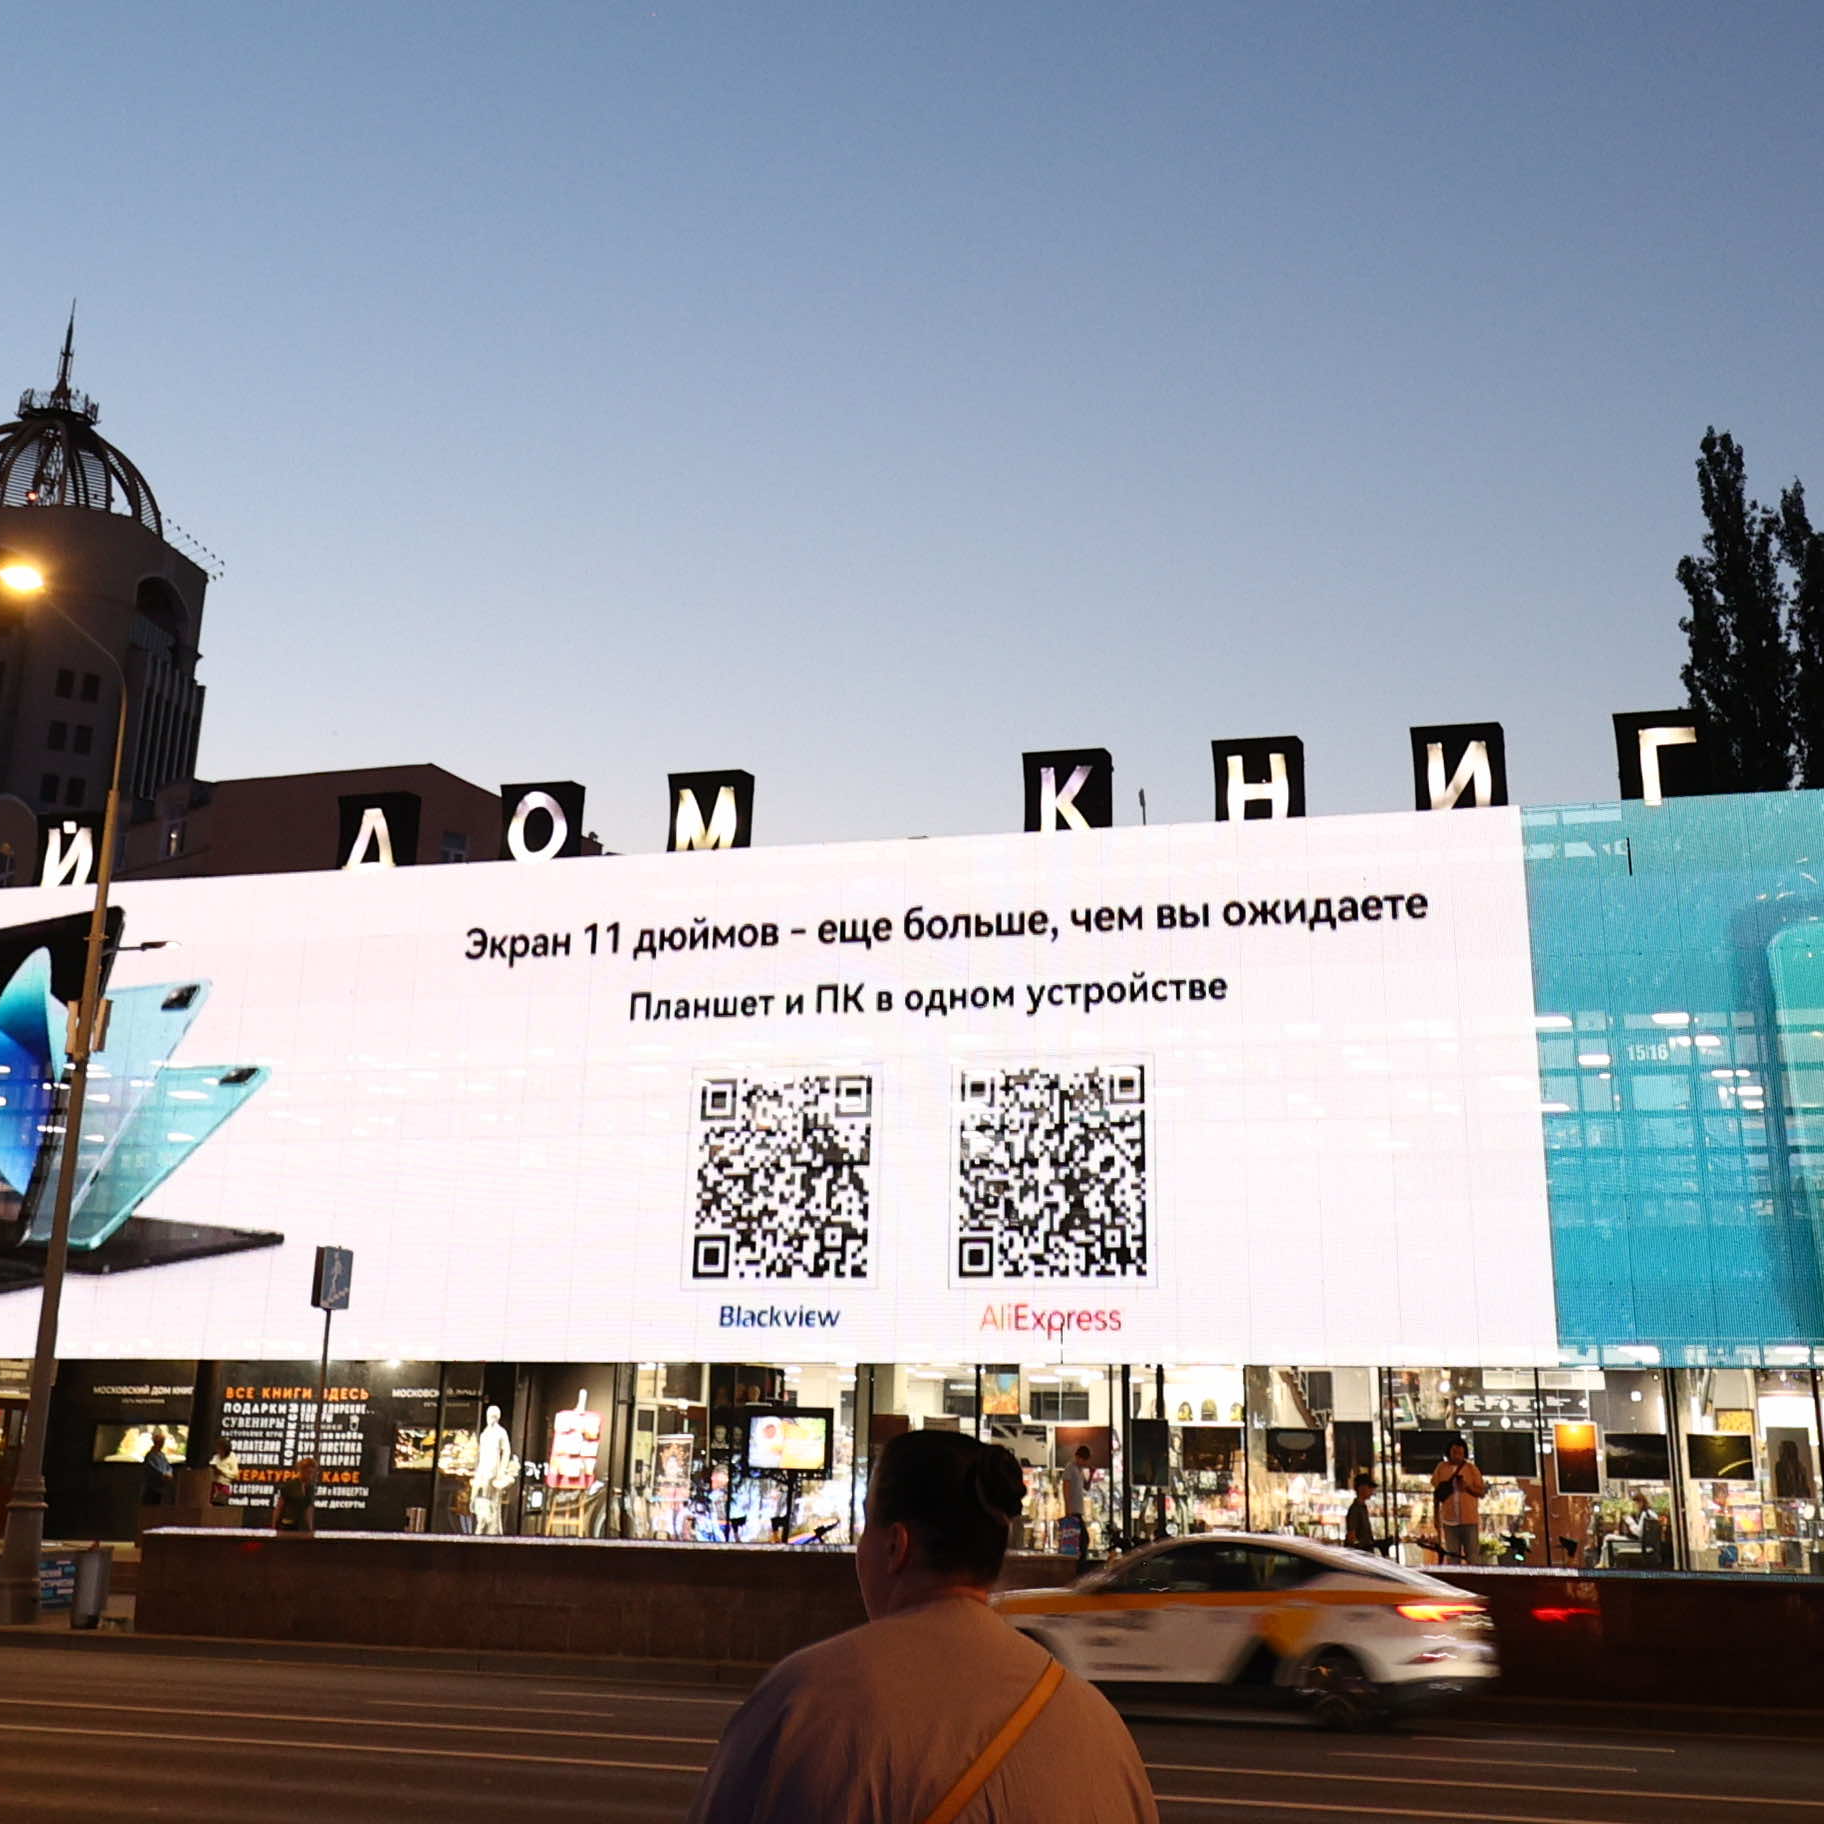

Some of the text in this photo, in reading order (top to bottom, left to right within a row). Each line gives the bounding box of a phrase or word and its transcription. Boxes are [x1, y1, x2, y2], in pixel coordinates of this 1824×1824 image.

[342, 785, 737, 871] ДОМ
[465, 928, 571, 968] Экран
[584, 922, 620, 954] 11
[633, 917, 779, 961] дюймов
[818, 918, 893, 950] еще
[904, 906, 1059, 943] больше,
[1070, 906, 1143, 933] чем
[1157, 903, 1210, 929] вы
[1223, 893, 1429, 931] ожидаете
[629, 972, 1228, 1021] Планшет и ПК в одном устройстве
[719, 1305, 840, 1328] Blackview
[980, 1304, 1122, 1339] AliExpress
[226, 1387, 256, 1399] ВСЕ
[262, 1387, 313, 1400] КНИГИ
[223, 1402, 287, 1414] ПОДАРКИ
[300, 1414, 333, 1423] ТОВРЫ
[221, 1417, 285, 1429] СУВЕНИРЫ
